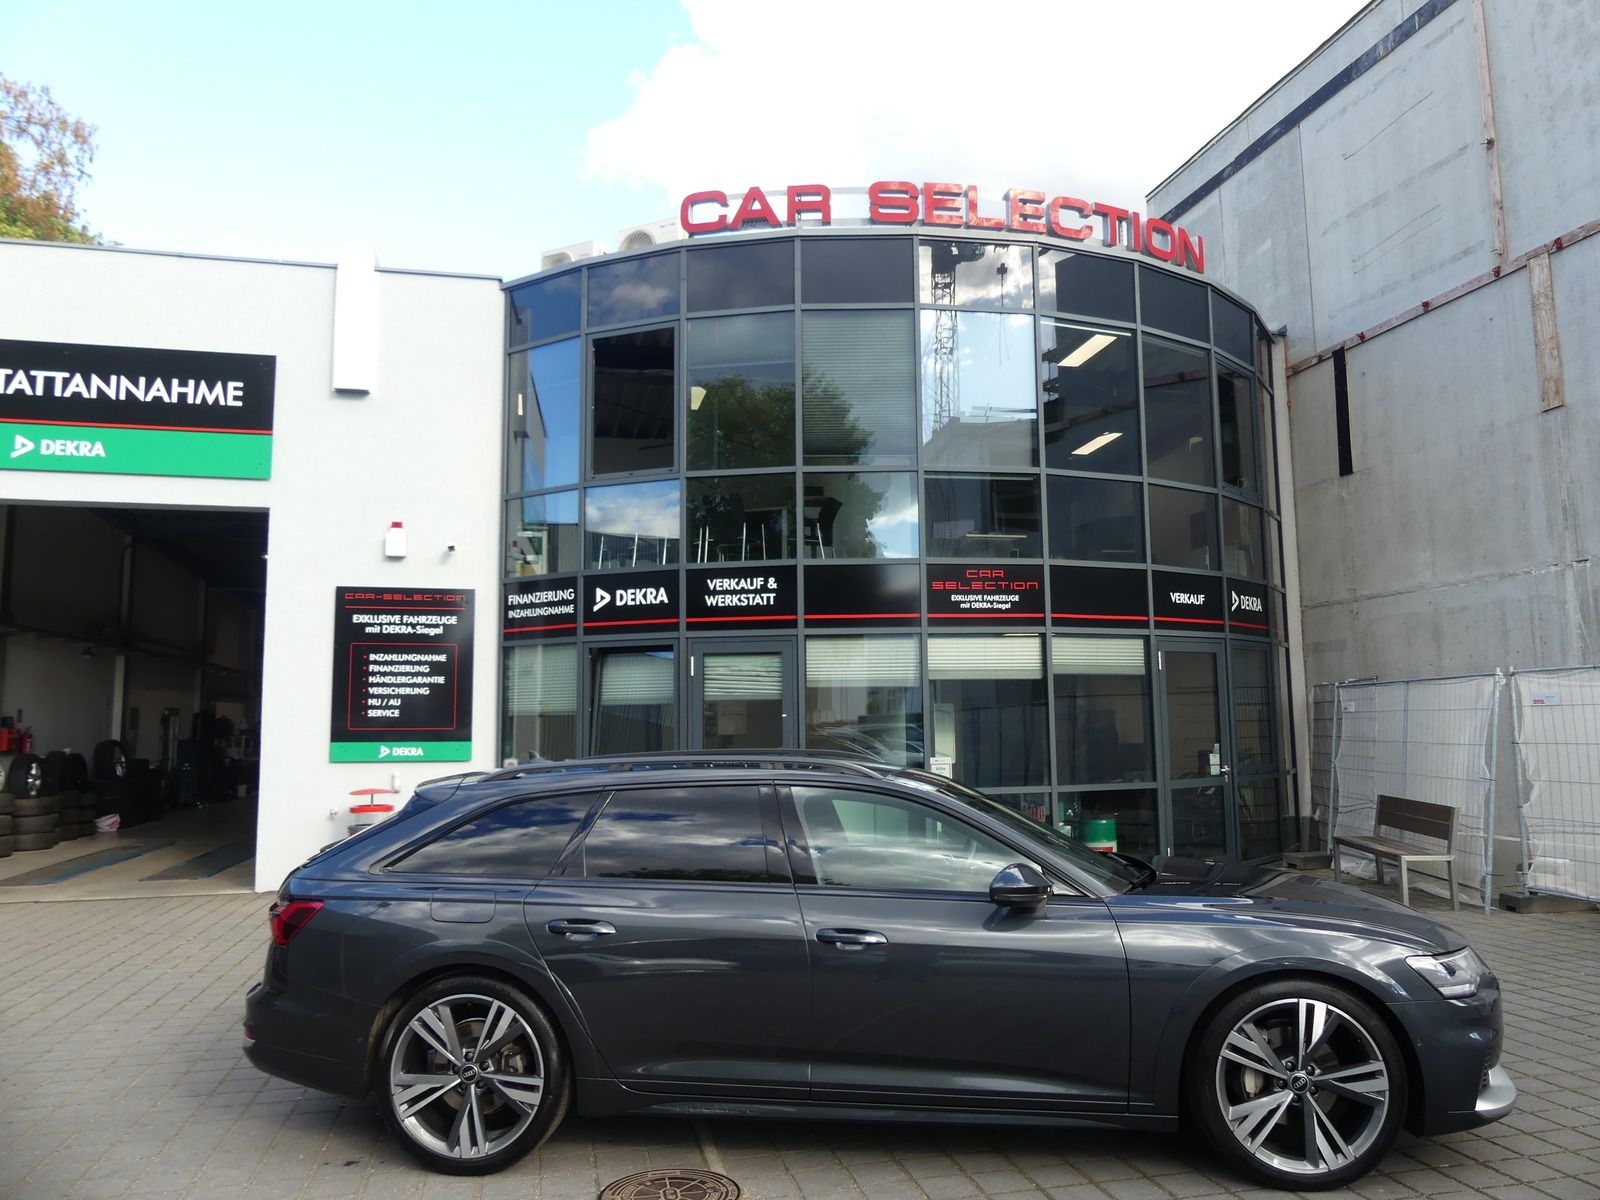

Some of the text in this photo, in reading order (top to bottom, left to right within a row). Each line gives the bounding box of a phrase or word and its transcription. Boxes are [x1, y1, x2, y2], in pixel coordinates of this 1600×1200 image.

[681, 181, 1206, 274] CAR SELECTION
[40, 439, 106, 457] DEKRA
[966, 569, 1005, 578] CAR
[706, 577, 778, 591] VERKAUF &
[931, 581, 1039, 590] SELECTION
[344, 592, 466, 603] CAR-SELECTION
[507, 588, 575, 606] FINANZIERUNG
[615, 587, 669, 606] DEKRA
[704, 593, 777, 606] WERKSTATT
[951, 594, 1019, 602] EXKLUSIVE FAHRZEUGE
[1169, 593, 1205, 605] VERKAUF
[971, 602, 1011, 610] DEKRA-Siegel
[1240, 595, 1263, 611] DEKRA
[507, 604, 575, 620] INZAHLUNGNAHME
[352, 615, 458, 625] EXKLUSIVE FAHRZEUGE
[365, 625, 443, 636] mit DEKRA-Siegel
[369, 653, 447, 662] INZAHLUNGNAHME
[369, 665, 430, 673] FINANZIERUNG
[368, 675, 446, 684] HÄNDLERGARANTIE
[368, 686, 430, 695] VERSICHERUNG
[368, 698, 382, 706] HU
[388, 698, 402, 706] AU
[367, 710, 400, 718] SERVICE
[391, 746, 424, 757] DEKRA
